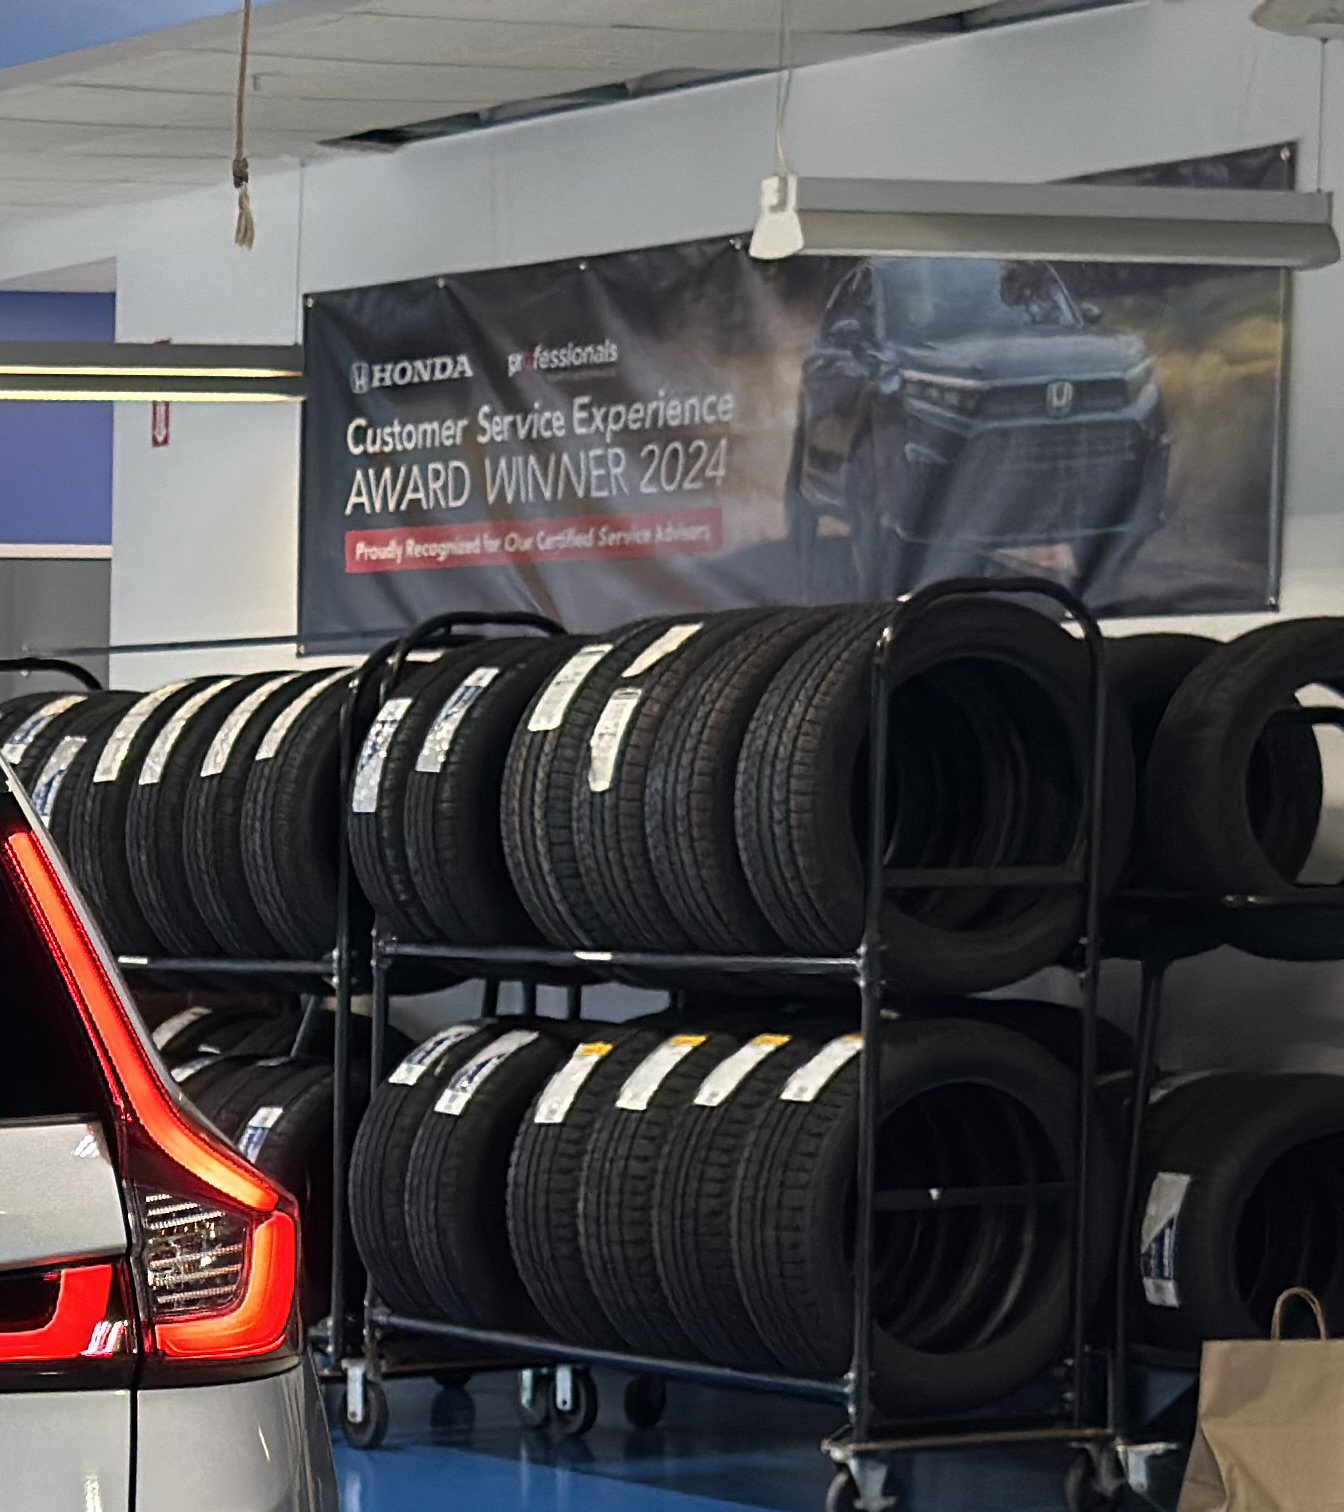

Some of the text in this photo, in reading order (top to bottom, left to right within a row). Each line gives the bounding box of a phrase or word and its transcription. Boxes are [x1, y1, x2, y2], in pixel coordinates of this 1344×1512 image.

[372, 354, 474, 389] HONDA
[346, 387, 735, 456] Customer Service Experience
[344, 438, 729, 516] AWARD WINNER 2024
[598, 523, 653, 547] Service
